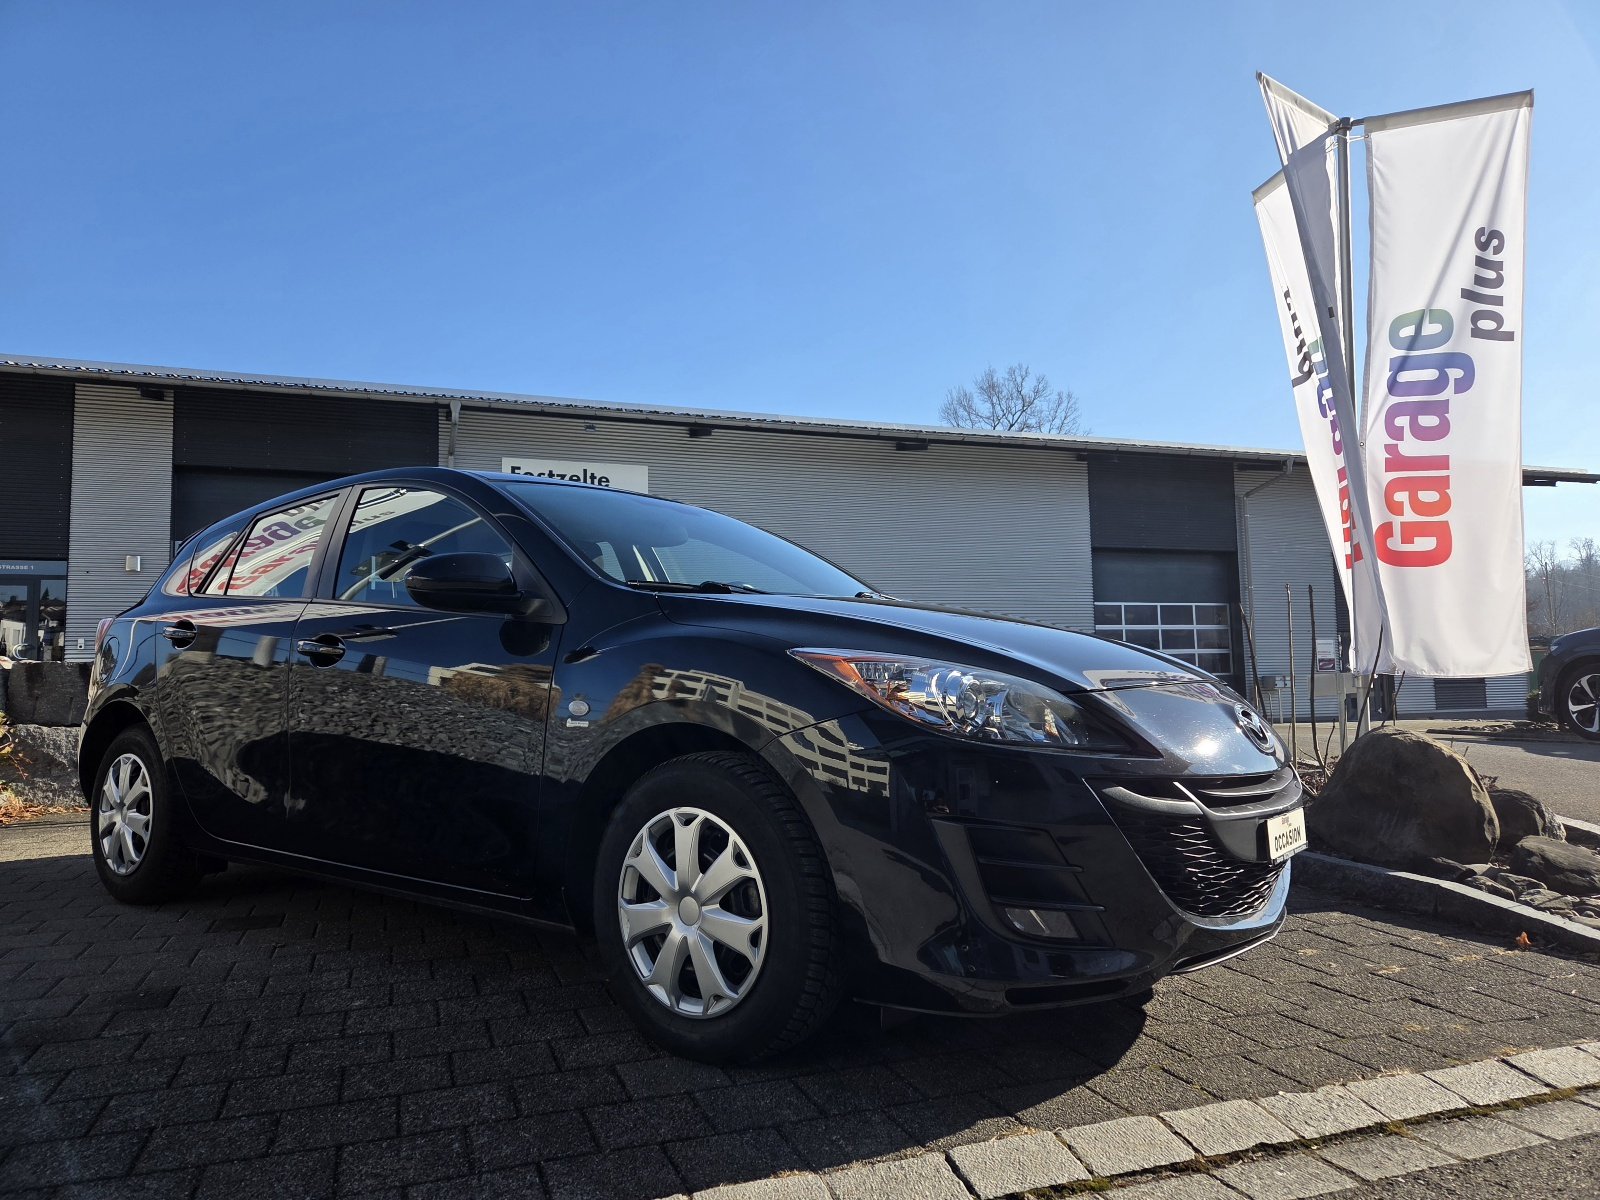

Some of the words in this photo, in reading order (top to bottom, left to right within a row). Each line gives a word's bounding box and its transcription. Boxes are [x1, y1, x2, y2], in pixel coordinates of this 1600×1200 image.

[1461, 227, 1514, 341] plus
[1374, 308, 1475, 567] Garage
[1274, 825, 1302, 852] OCCASION
